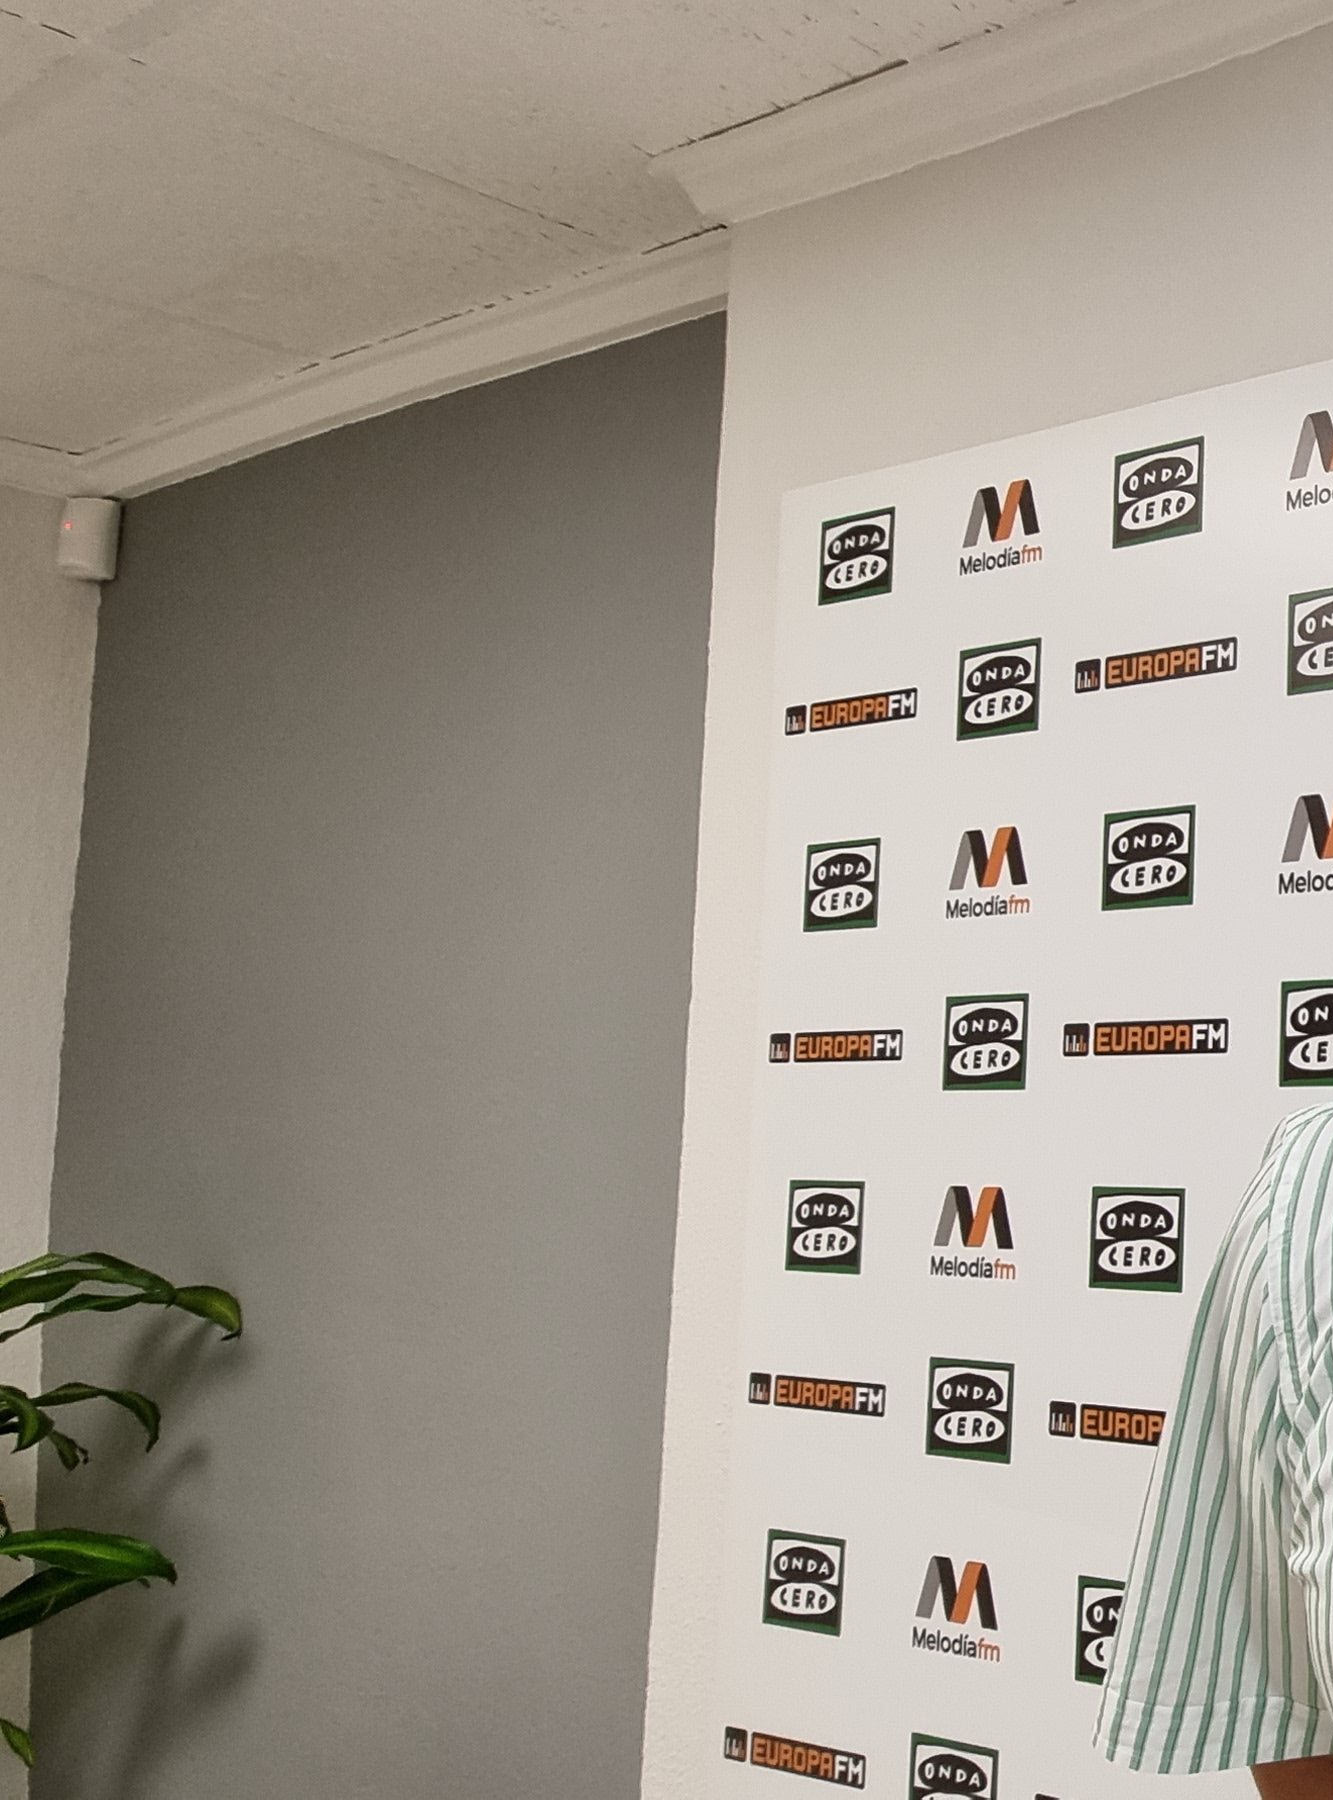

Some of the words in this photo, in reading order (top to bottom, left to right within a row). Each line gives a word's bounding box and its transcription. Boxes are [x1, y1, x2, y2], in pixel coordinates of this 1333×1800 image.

[1129, 464, 1188, 492] ONDA
[1130, 495, 1187, 523] CERO
[833, 530, 882, 554] ONDA
[833, 558, 880, 585] CERO
[959, 544, 1043, 576] Melodíafm
[973, 662, 1025, 685] ONDA
[1108, 641, 1235, 684] EUROPAFM
[811, 691, 915, 729] EUROPAFM
[973, 693, 1024, 718] CERO
[1119, 831, 1178, 854] ONDA
[817, 861, 866, 881] ONDA
[1120, 863, 1176, 887] CERO
[817, 891, 864, 911] CERO
[945, 894, 1030, 920] Melodíafm
[958, 1018, 1012, 1034] ONDA
[1096, 1024, 1226, 1052] EUROPAFM
[796, 1034, 900, 1060] EUROPAFM
[960, 1049, 1010, 1070] CERO
[801, 1202, 850, 1219] ONDA
[1107, 1212, 1166, 1230] ONDA
[801, 1232, 848, 1252] CERO
[930, 1256, 1016, 1280] Melodíafm
[1110, 1246, 1165, 1266] CERO
[777, 1379, 884, 1414] EUROPAFM
[942, 1383, 997, 1401] ONDA
[944, 1416, 996, 1437] CERO
[1083, 1409, 1165, 1441] EUROP
[779, 1555, 830, 1576] ONDA
[781, 1588, 828, 1610] CERO
[1093, 1605, 1120, 1622] ON
[912, 1627, 1000, 1662] Melodíafm
[753, 1737, 863, 1785] EUROPAFM
[924, 1762, 981, 1788] ONDA
